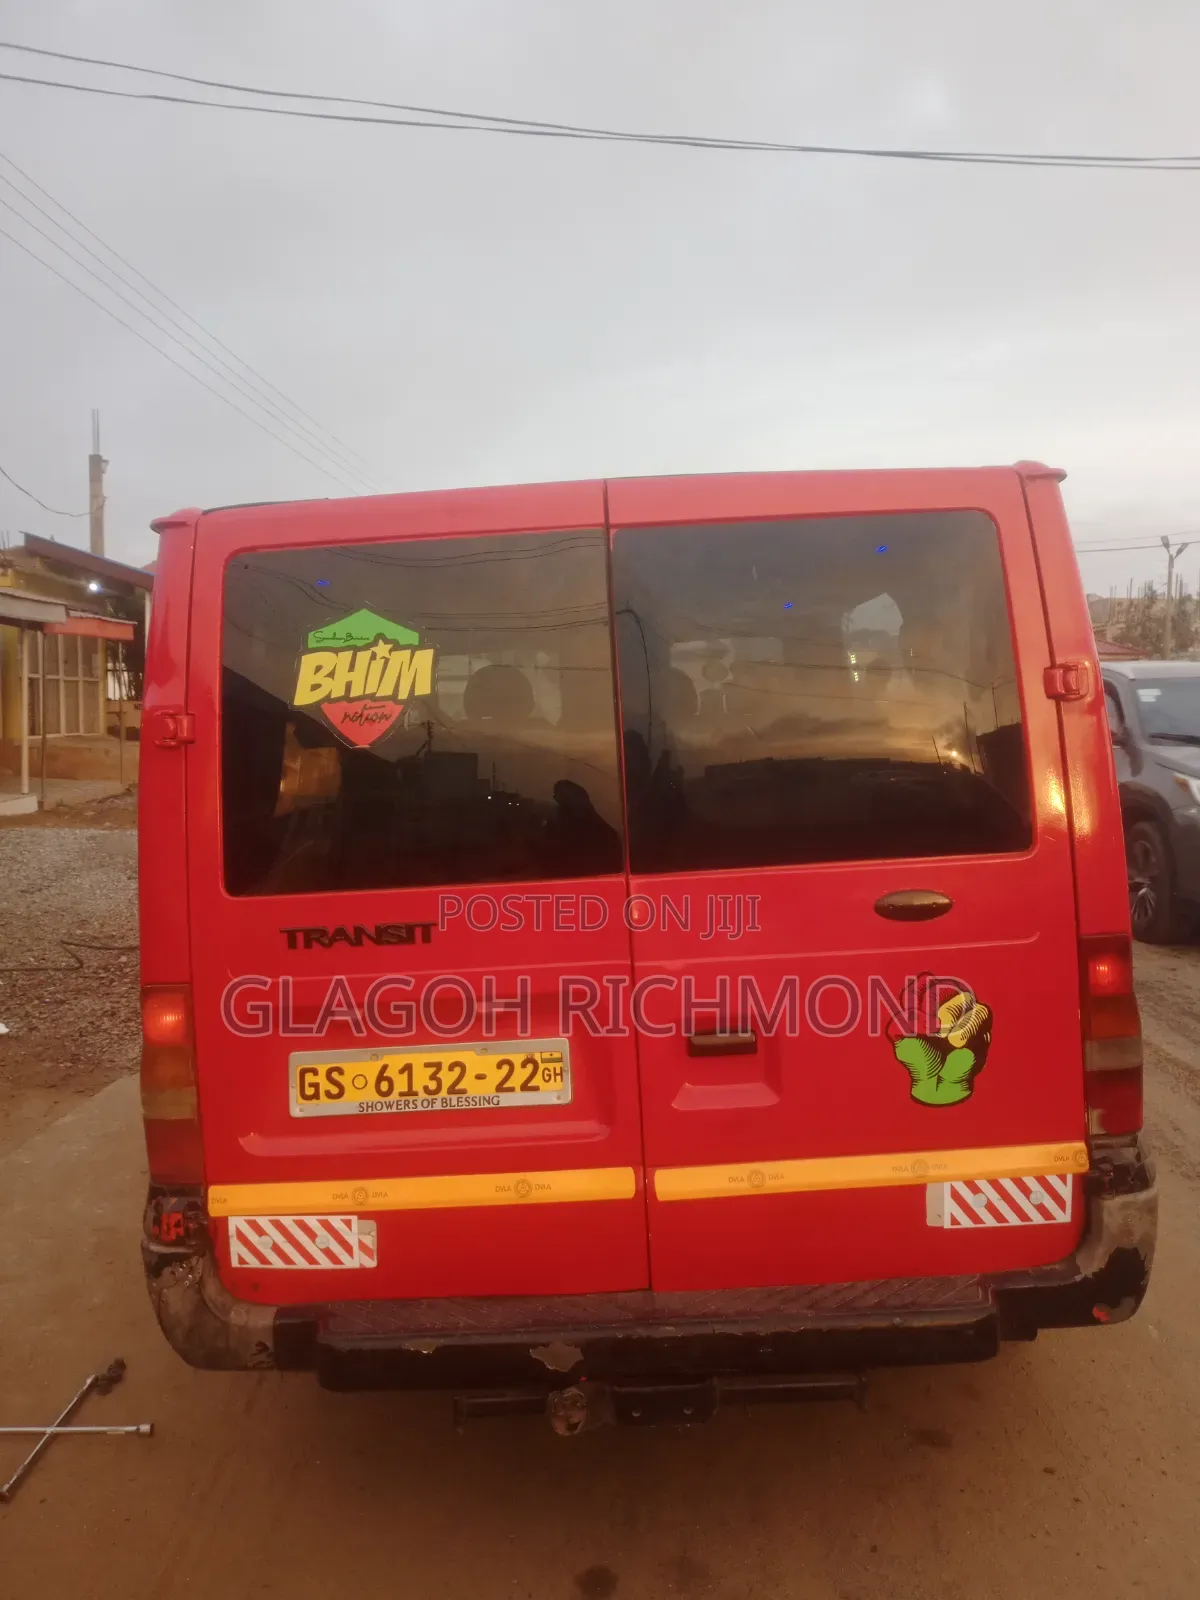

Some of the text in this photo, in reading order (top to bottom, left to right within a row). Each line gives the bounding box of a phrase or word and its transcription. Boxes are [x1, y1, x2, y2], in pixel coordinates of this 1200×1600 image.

[279, 922, 438, 950] TRANSIT
[299, 1058, 563, 1101] GS 6132-22 GH
[358, 1095, 500, 1113] SHOWERS OF BLESSING
